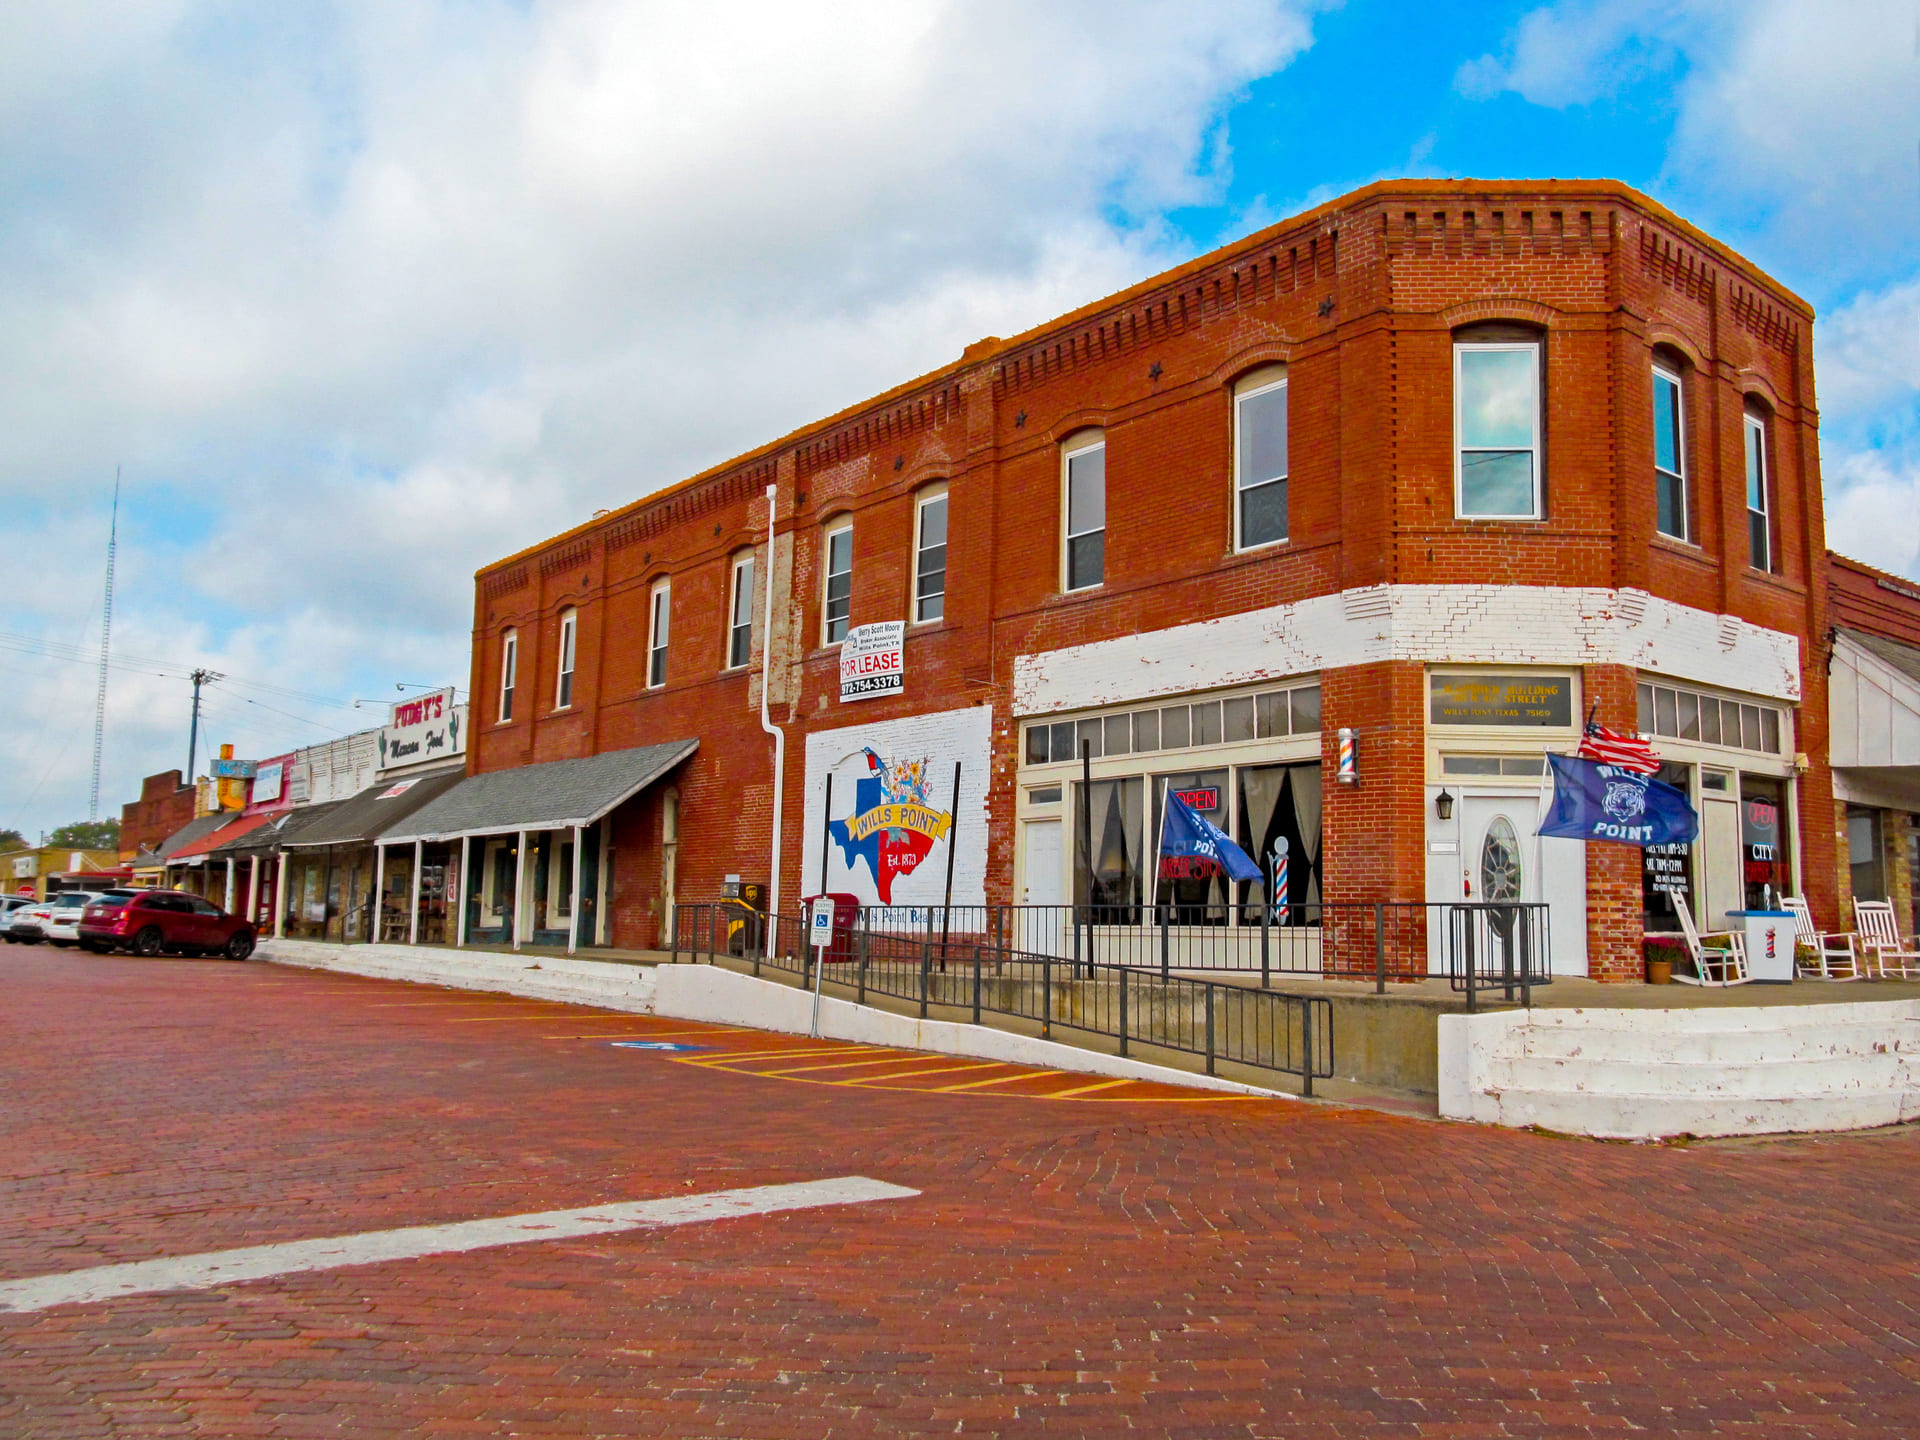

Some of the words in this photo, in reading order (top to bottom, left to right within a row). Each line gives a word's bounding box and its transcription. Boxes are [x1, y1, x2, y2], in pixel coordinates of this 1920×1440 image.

[841, 659, 857, 677] FOR
[858, 652, 900, 673] LEASE
[841, 675, 900, 695] 972-754-3378
[394, 695, 443, 729] PUDGY'S
[1175, 791, 1216, 809] OPEN
[857, 808, 892, 835] WILLS
[900, 808, 939, 833] POINT
[1748, 803, 1776, 824] OPEN
[1593, 822, 1654, 841] POINT
[901, 854, 917, 866] 1873
[1753, 844, 1774, 860] CITY
